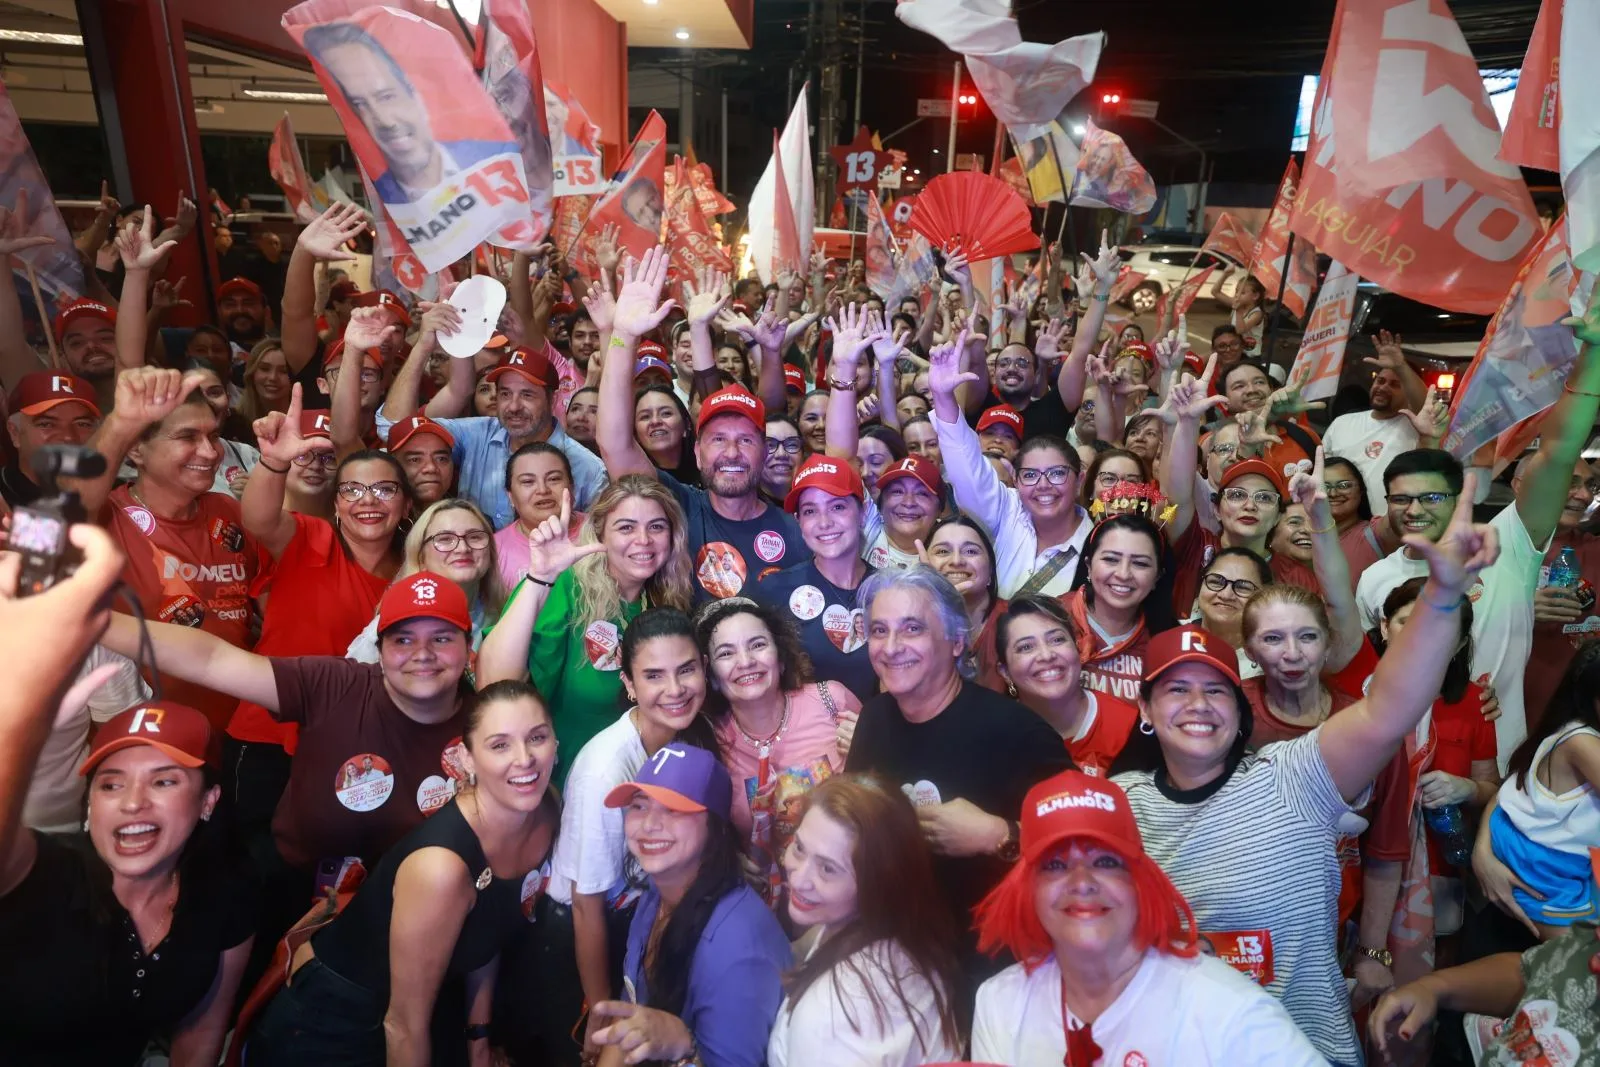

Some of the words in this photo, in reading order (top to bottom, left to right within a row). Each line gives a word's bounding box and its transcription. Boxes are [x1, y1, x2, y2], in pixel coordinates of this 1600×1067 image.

[565, 159, 597, 187] 13
[845, 151, 876, 183] 13
[465, 159, 529, 206] 13
[1305, 198, 1417, 274] AGUIAR
[509, 351, 526, 365] R
[52, 376, 74, 394] R
[901, 458, 917, 471] R
[414, 585, 435, 599] 13
[824, 620, 851, 631] 4077
[1181, 631, 1208, 653] R
[128, 707, 165, 734] R
[652, 747, 686, 775] T
[1235, 935, 1262, 956] 13
[1220, 954, 1265, 964] ELMANO
